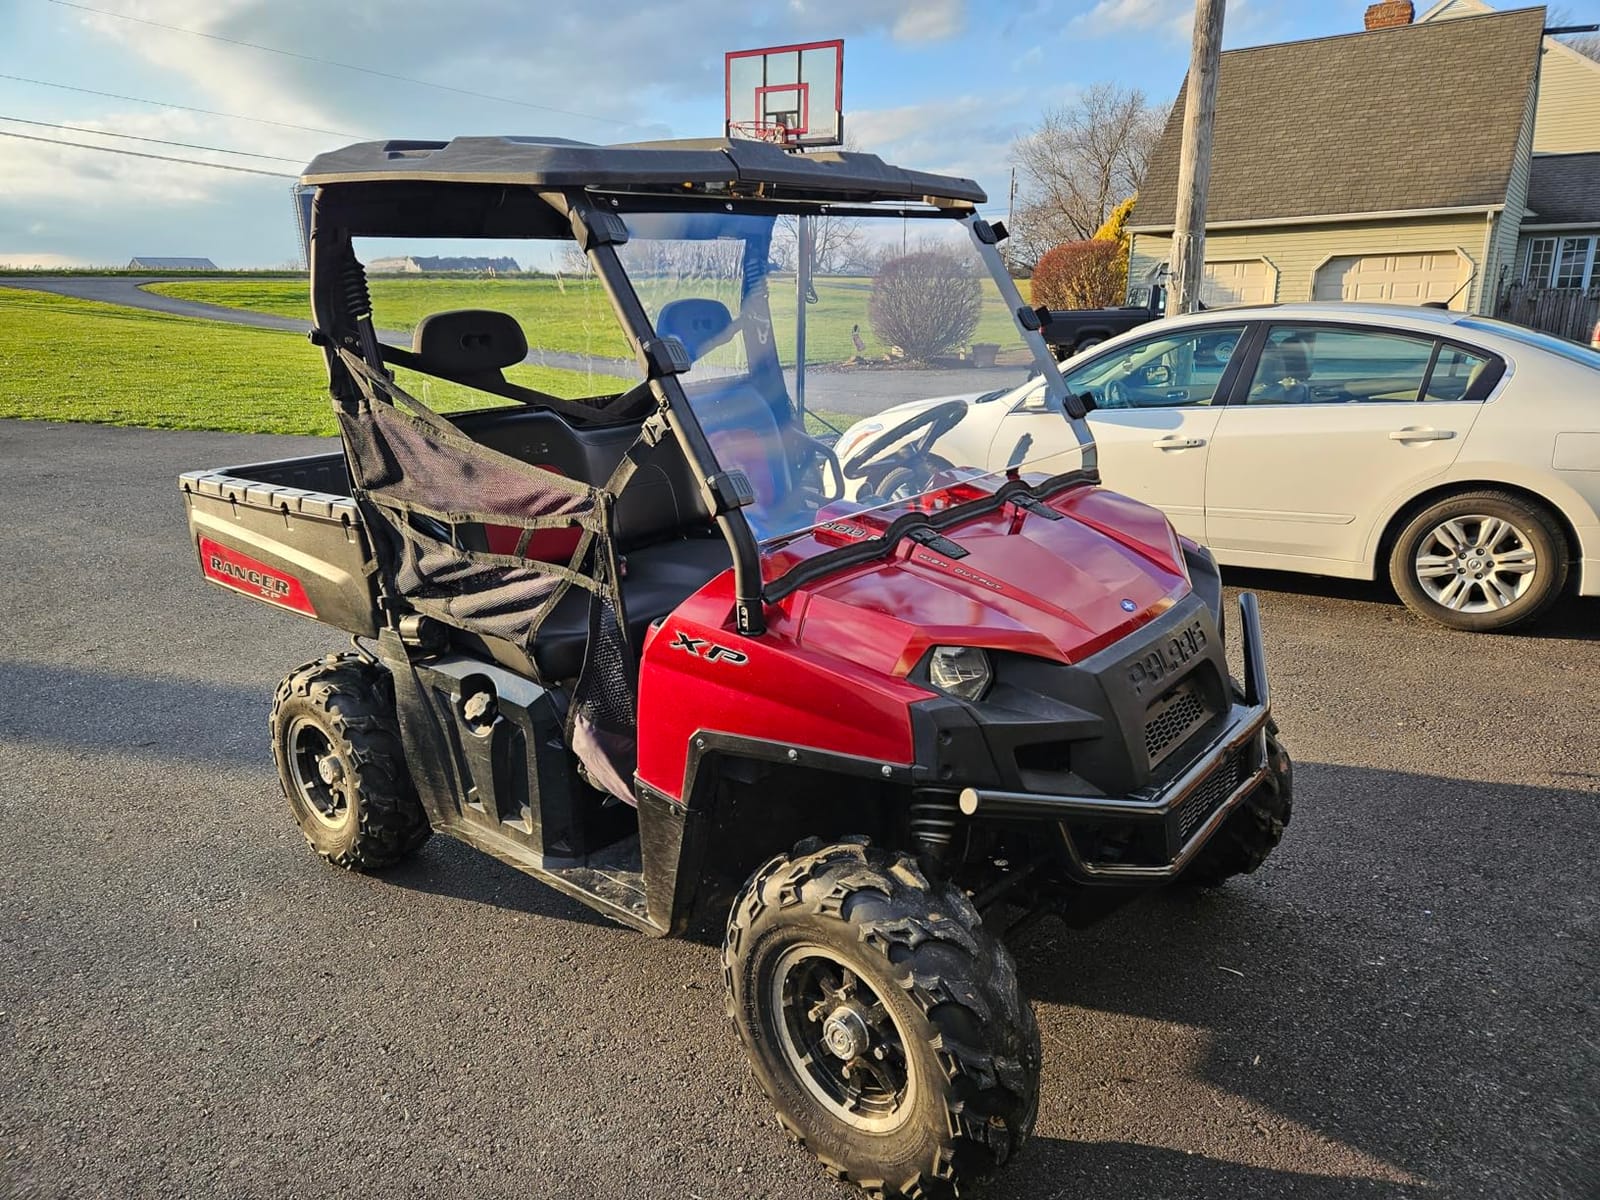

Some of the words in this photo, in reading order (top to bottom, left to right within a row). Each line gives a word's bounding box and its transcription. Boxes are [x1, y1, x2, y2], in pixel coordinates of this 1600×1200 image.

[820, 520, 866, 538] 800
[211, 556, 289, 595] RANGER
[918, 554, 948, 567] HIGH
[954, 567, 1002, 590] OUTPUT
[260, 588, 281, 599] XP
[671, 631, 748, 664] XP
[1128, 621, 1207, 696] POLARIS
